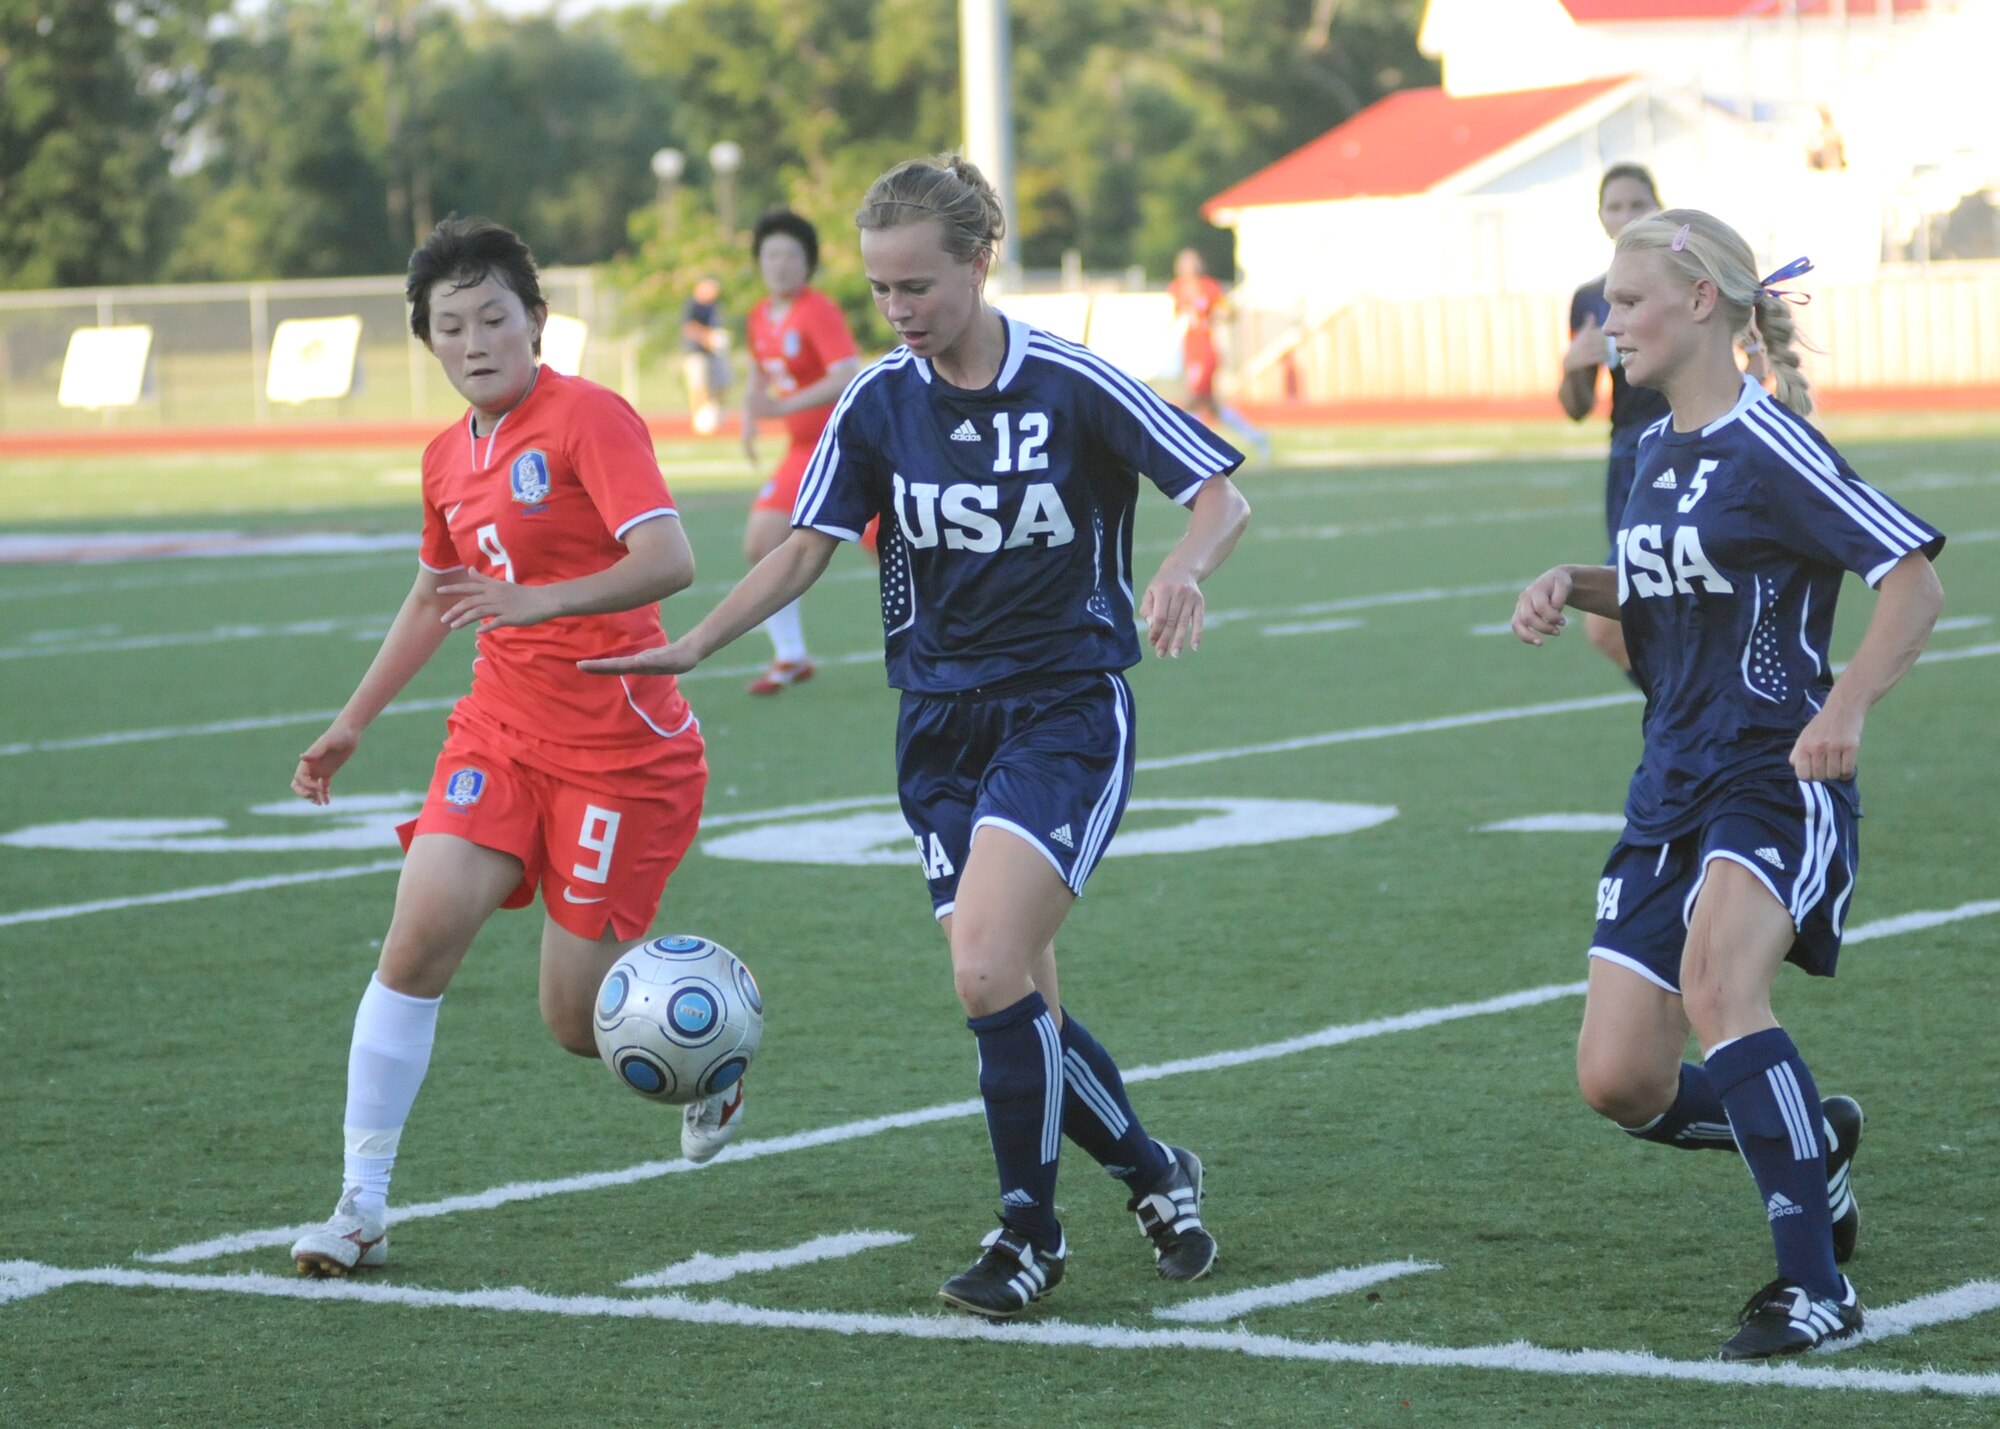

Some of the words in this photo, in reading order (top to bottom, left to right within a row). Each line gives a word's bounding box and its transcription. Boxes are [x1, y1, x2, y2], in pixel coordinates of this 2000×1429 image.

[950, 433, 981, 442] adidas
[993, 412, 1049, 472] 12
[893, 472, 1075, 553] USA
[1678, 458, 1719, 513] 5
[477, 523, 516, 584] 9
[573, 804, 621, 884] 9
